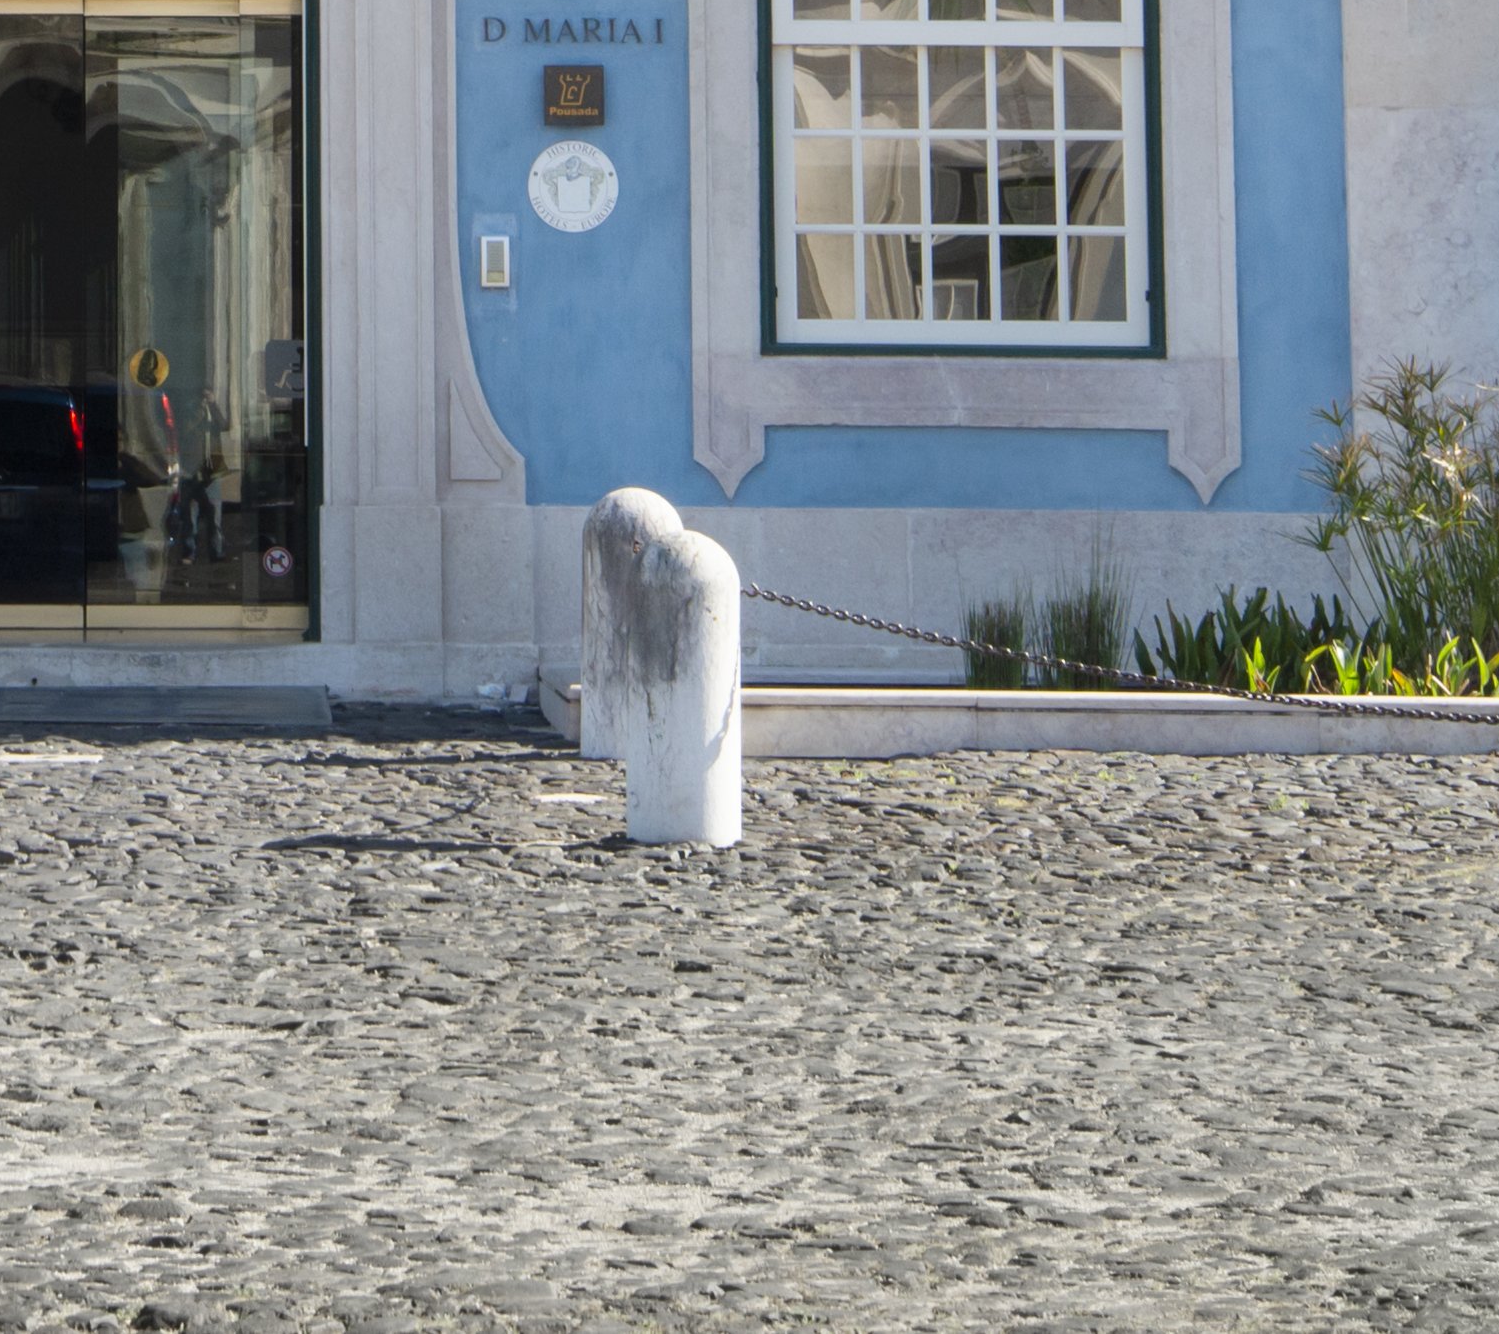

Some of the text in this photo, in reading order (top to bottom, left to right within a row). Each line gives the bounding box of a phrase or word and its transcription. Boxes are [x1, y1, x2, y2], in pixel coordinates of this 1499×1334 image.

[482, 17, 664, 44] D MARIA I
[549, 106, 599, 116] Pousada
[545, 143, 600, 159] HISTORIC
[532, 196, 615, 230] HOTELS EUROPE
